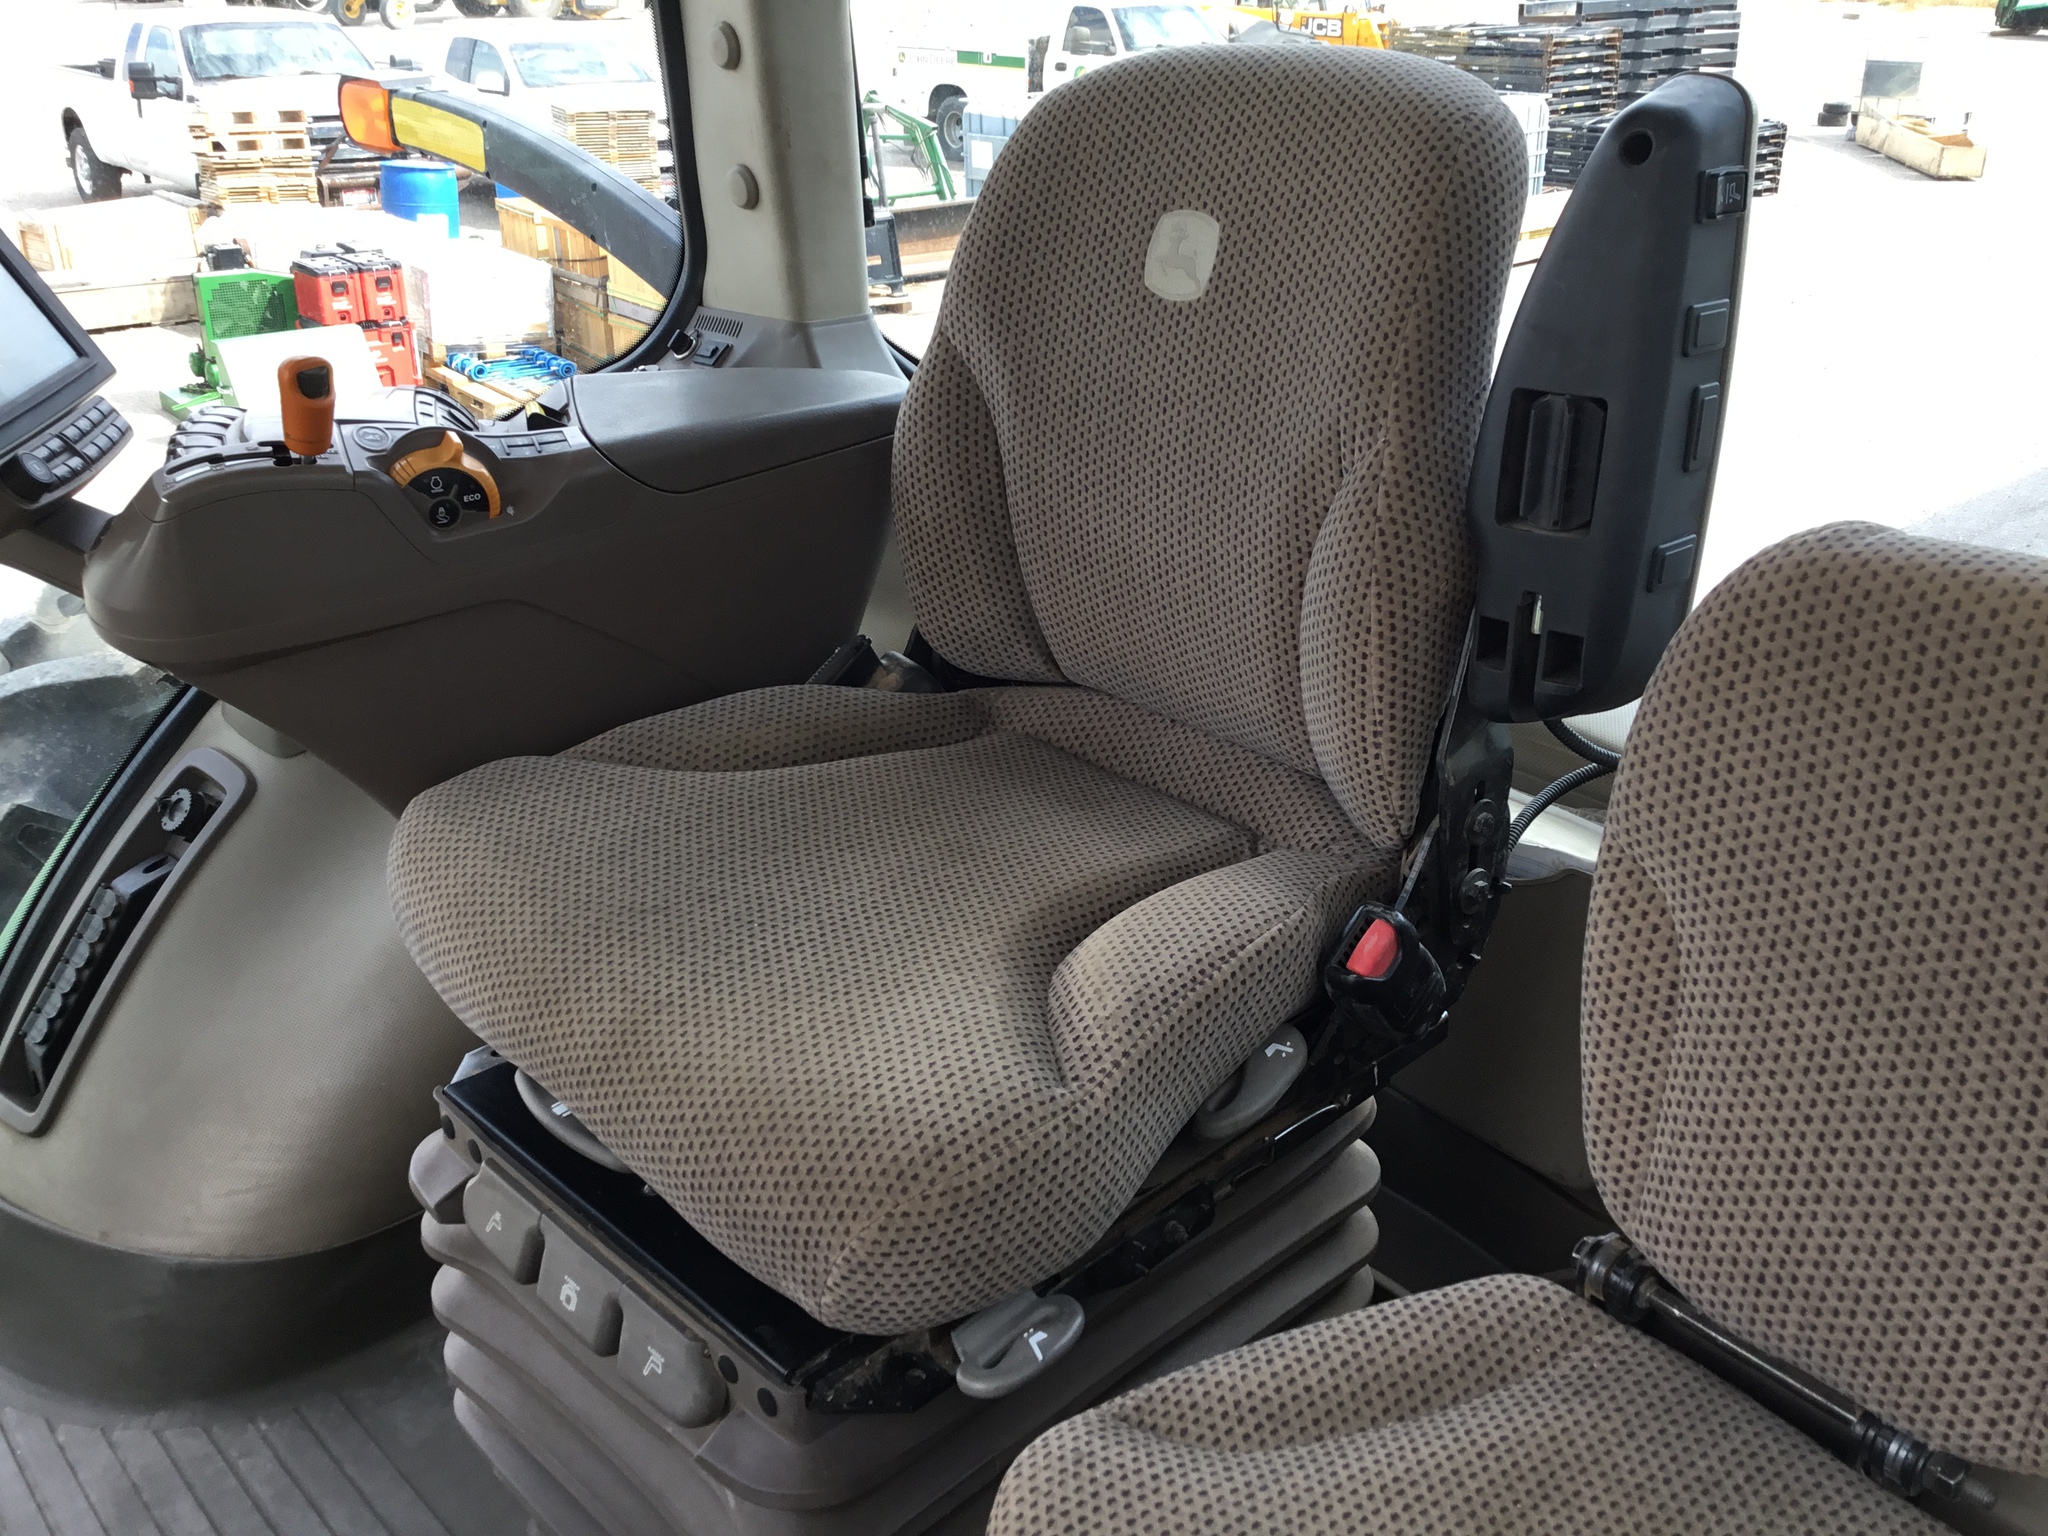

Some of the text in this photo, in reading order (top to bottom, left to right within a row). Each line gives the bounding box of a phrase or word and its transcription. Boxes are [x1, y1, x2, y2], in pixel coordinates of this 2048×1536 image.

[1301, 17, 1342, 37] JCB
[929, 53, 955, 65] DEERE
[463, 493, 481, 503] ECO
